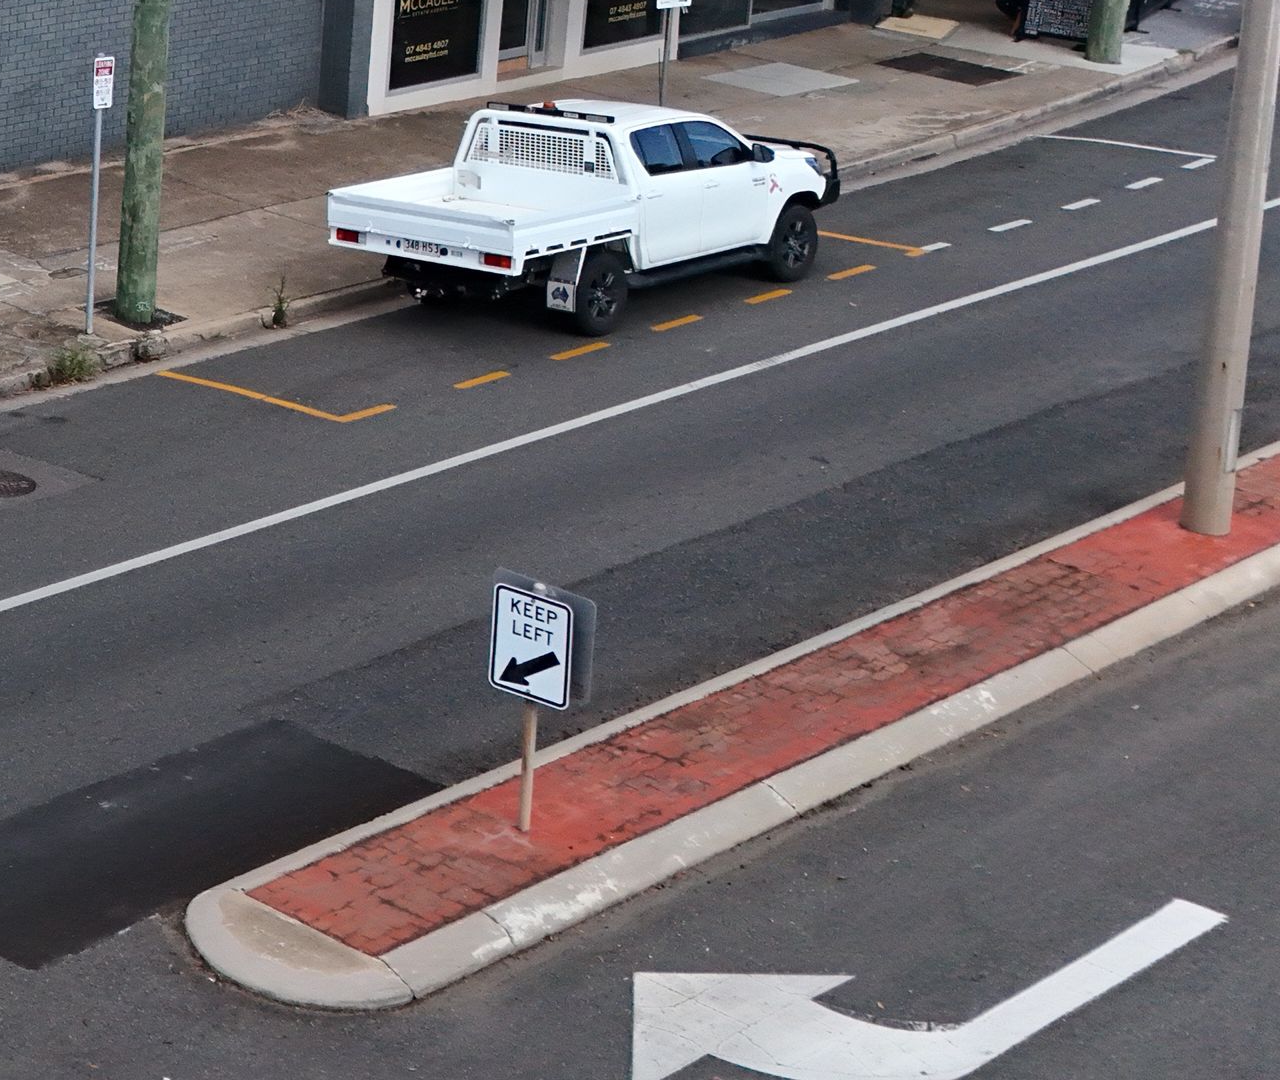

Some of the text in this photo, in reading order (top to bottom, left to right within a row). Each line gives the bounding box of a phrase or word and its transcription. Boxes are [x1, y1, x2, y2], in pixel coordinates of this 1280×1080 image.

[610, 6, 617, 16] 07
[406, 46, 414, 54] 07
[422, 243, 438, 254] HS3
[510, 598, 558, 624] KEEP
[512, 620, 554, 646] LEFT
